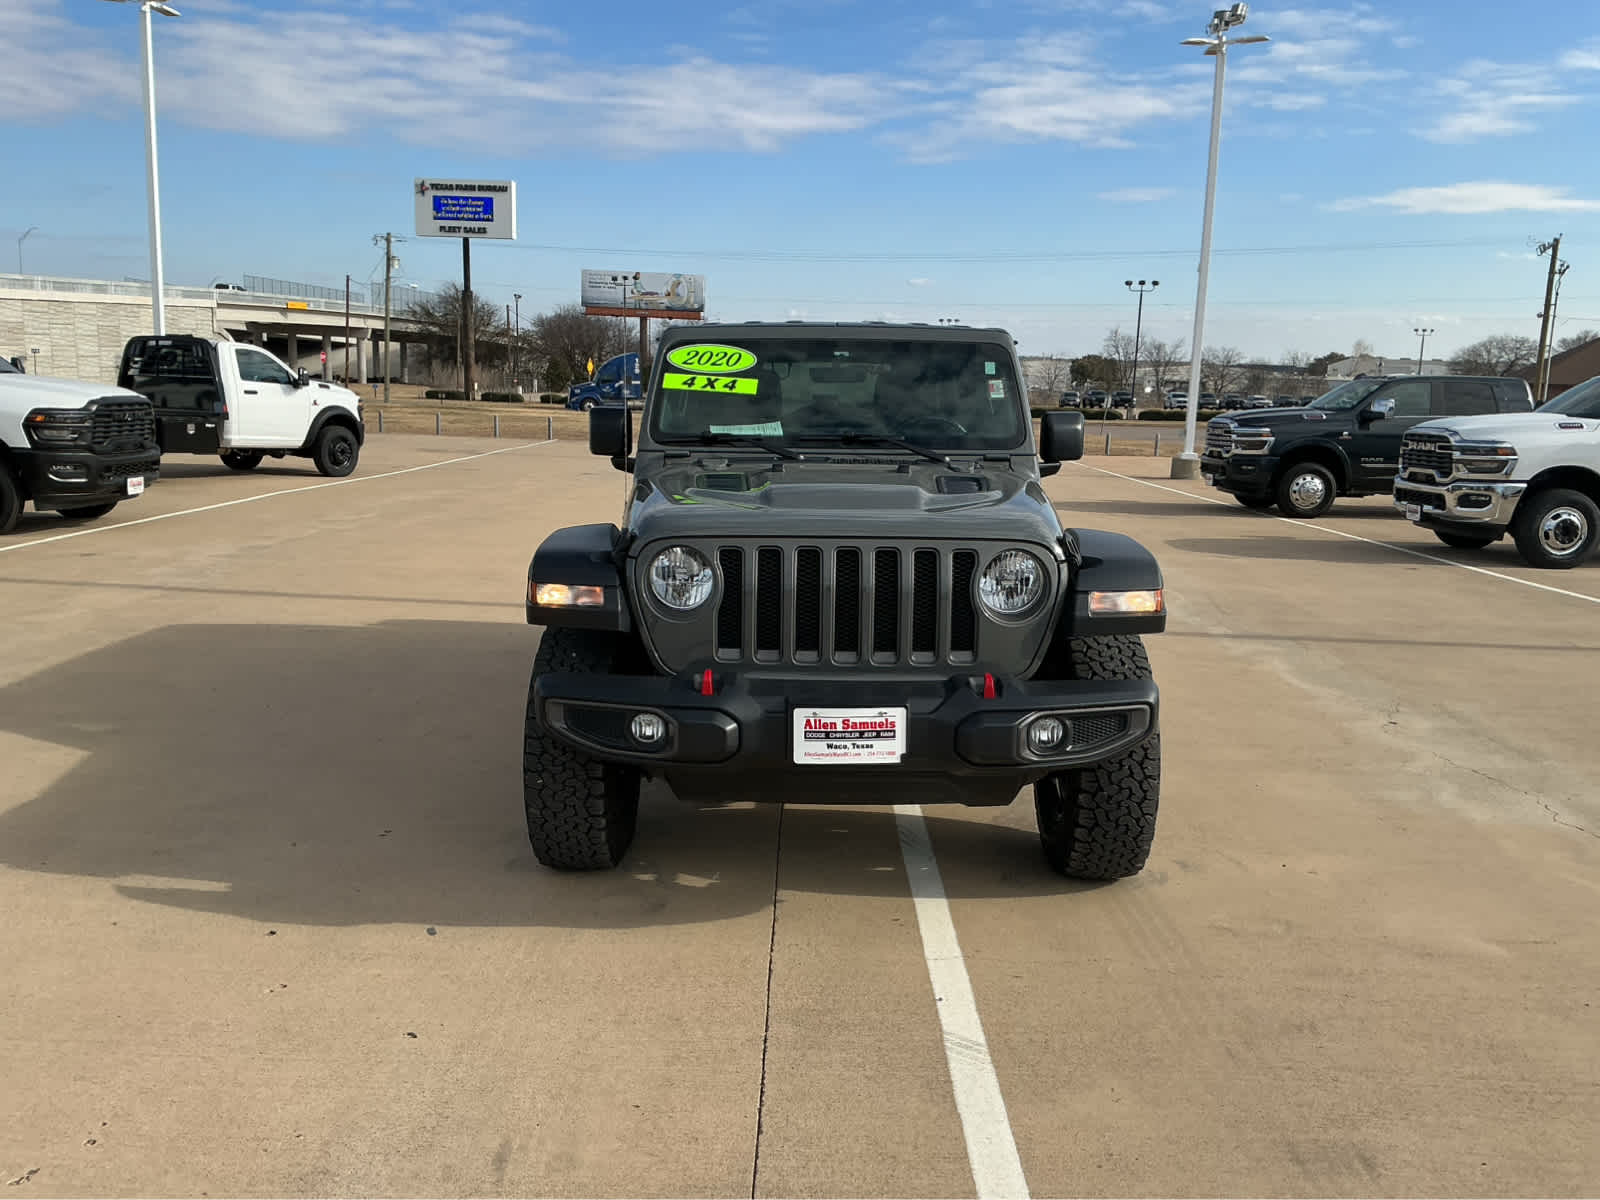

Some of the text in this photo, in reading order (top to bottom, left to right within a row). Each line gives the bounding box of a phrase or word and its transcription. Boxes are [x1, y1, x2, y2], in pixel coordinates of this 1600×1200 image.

[430, 183, 454, 191] TEXAS
[439, 225, 487, 234] FLEET SALES
[681, 350, 742, 368] 2020
[804, 718, 896, 730] Allen Samuels
